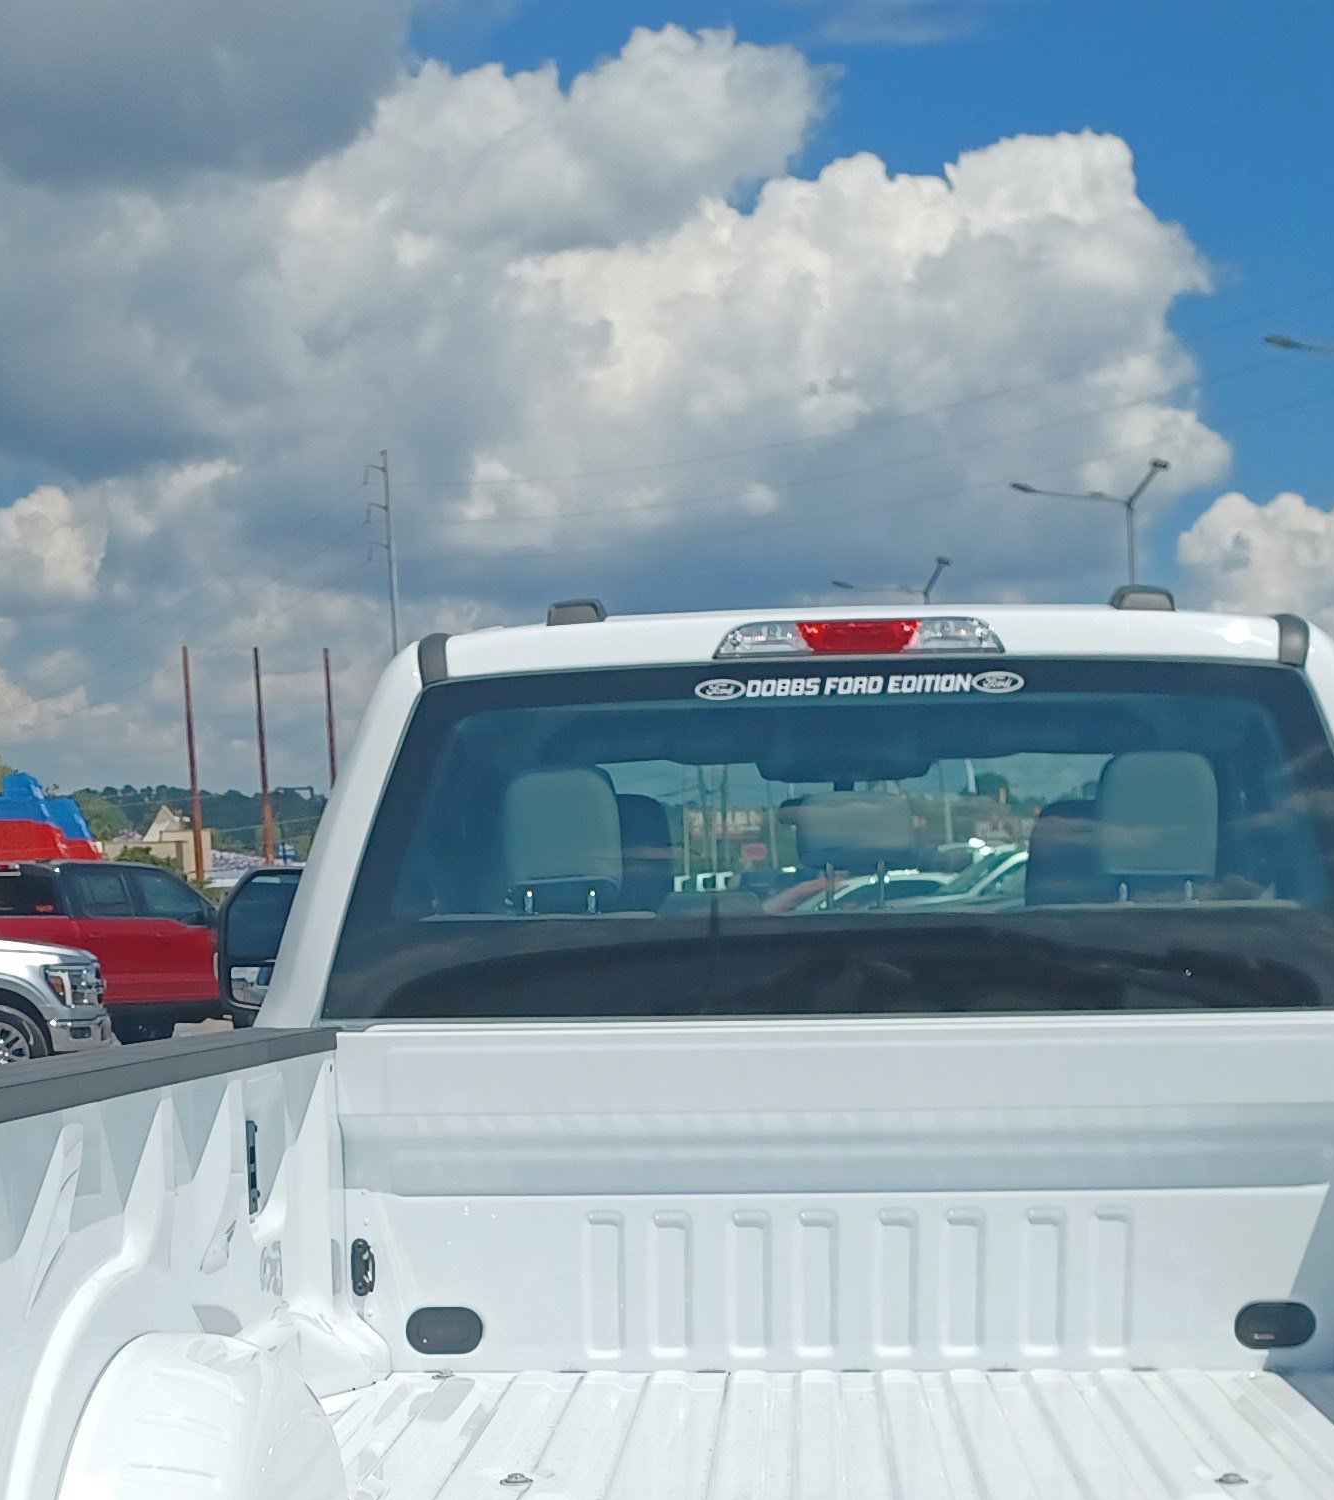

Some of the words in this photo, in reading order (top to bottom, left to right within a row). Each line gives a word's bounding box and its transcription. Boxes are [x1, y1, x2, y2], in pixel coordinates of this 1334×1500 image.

[746, 678, 821, 698] DOBBS
[824, 676, 884, 696] FORD
[887, 673, 973, 694] EDITION
